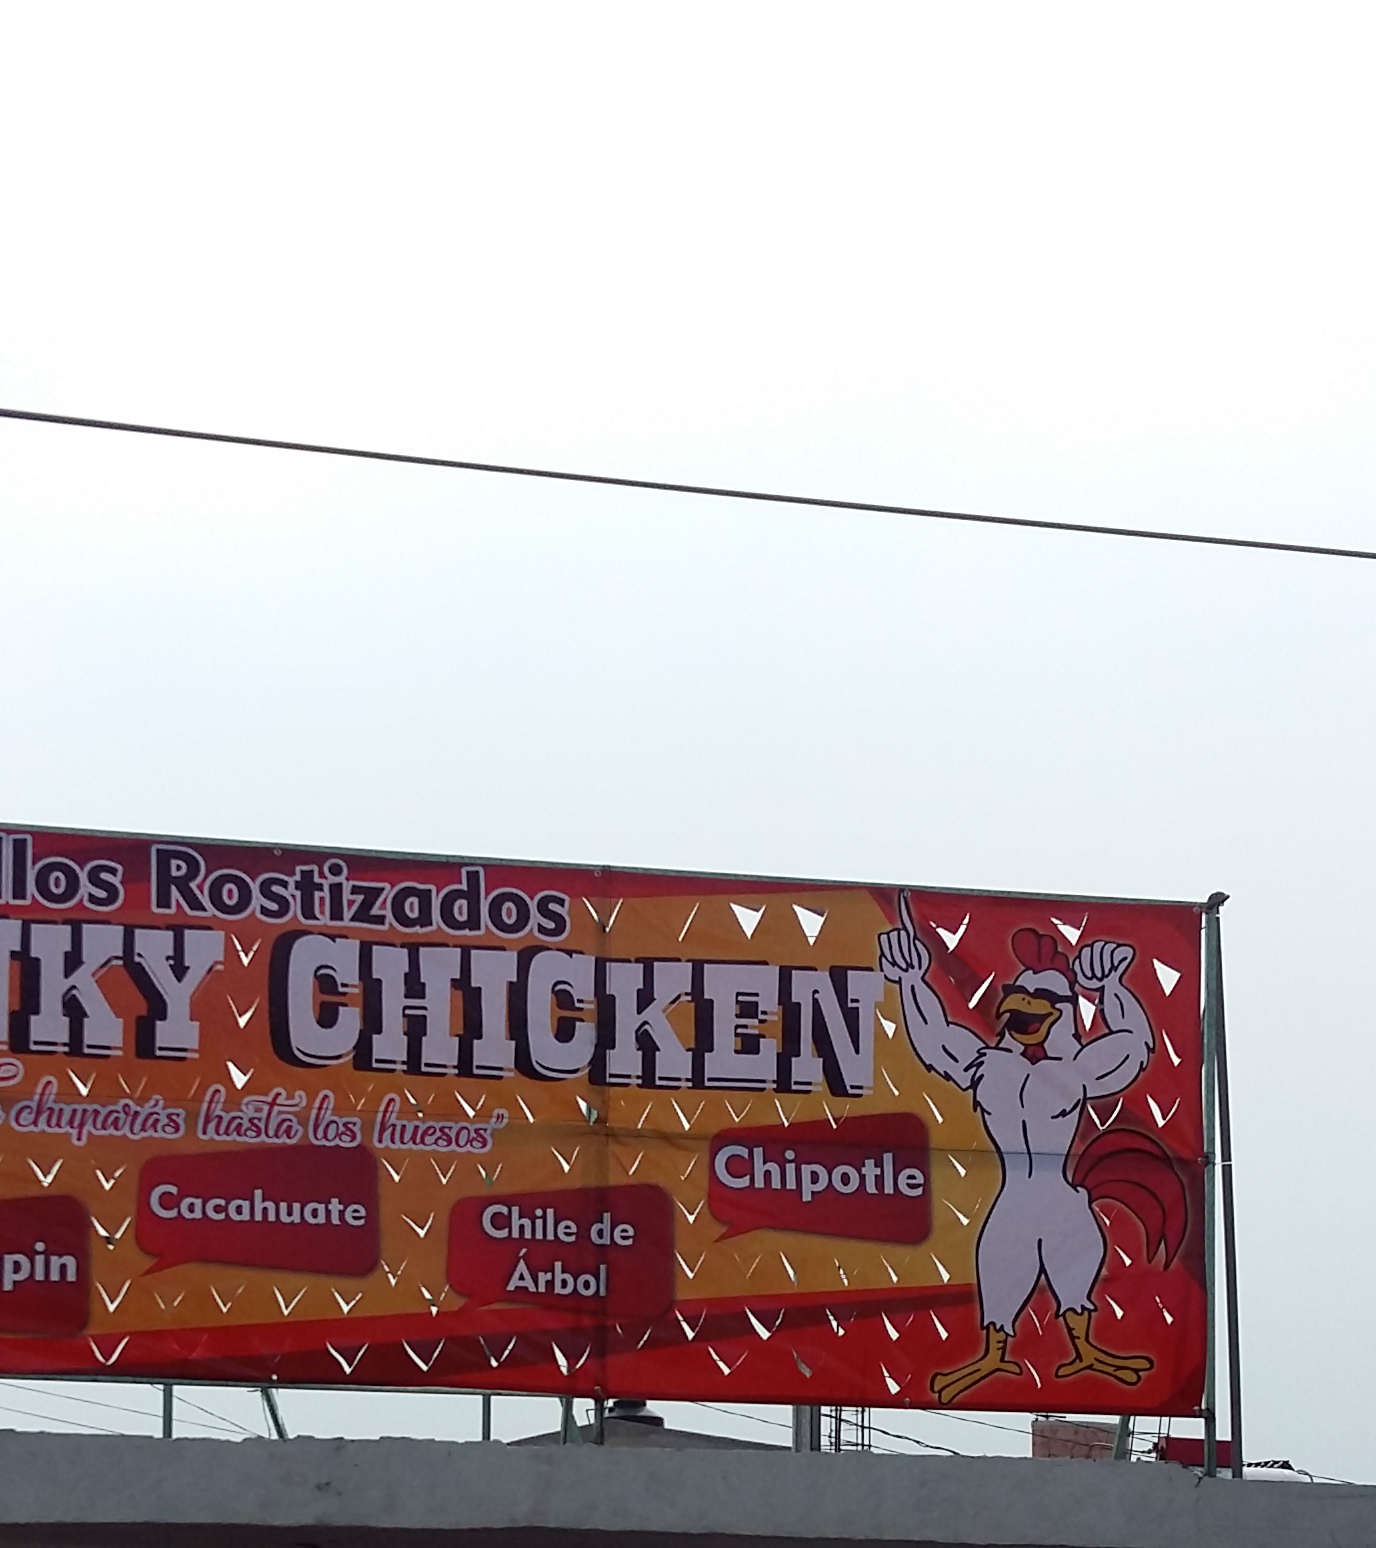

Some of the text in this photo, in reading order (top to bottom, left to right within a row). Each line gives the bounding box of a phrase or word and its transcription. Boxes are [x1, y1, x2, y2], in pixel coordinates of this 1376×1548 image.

[149, 841, 570, 941] Rostizados
[269, 928, 885, 1097] CHICKEN
[8, 1074, 186, 1146] chuparás
[199, 1088, 304, 1145] hasta
[307, 1090, 362, 1150] los
[374, 1092, 509, 1154] huesos"
[713, 1145, 925, 1201] Chipotle
[149, 1182, 367, 1228] Cacahuate
[482, 1203, 635, 1247] Chile de
[506, 1248, 607, 1299] Árbol
